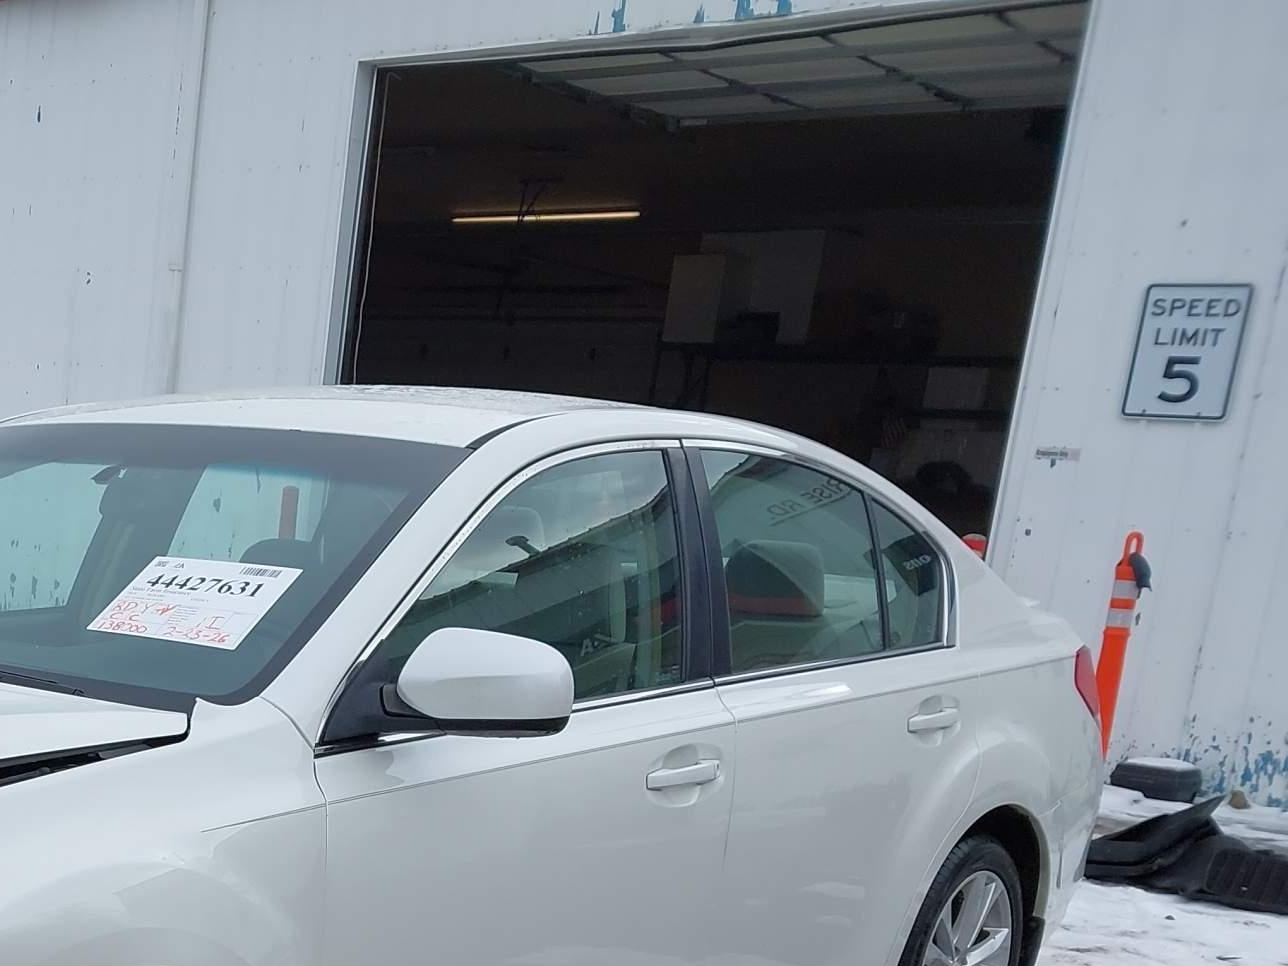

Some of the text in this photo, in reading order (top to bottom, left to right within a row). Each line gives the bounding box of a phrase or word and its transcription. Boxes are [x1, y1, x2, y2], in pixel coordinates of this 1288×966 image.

[1151, 298, 1241, 318] SPEED
[1153, 327, 1228, 347] LIMIT
[1157, 355, 1202, 403] 5
[146, 573, 265, 598] 44427631
